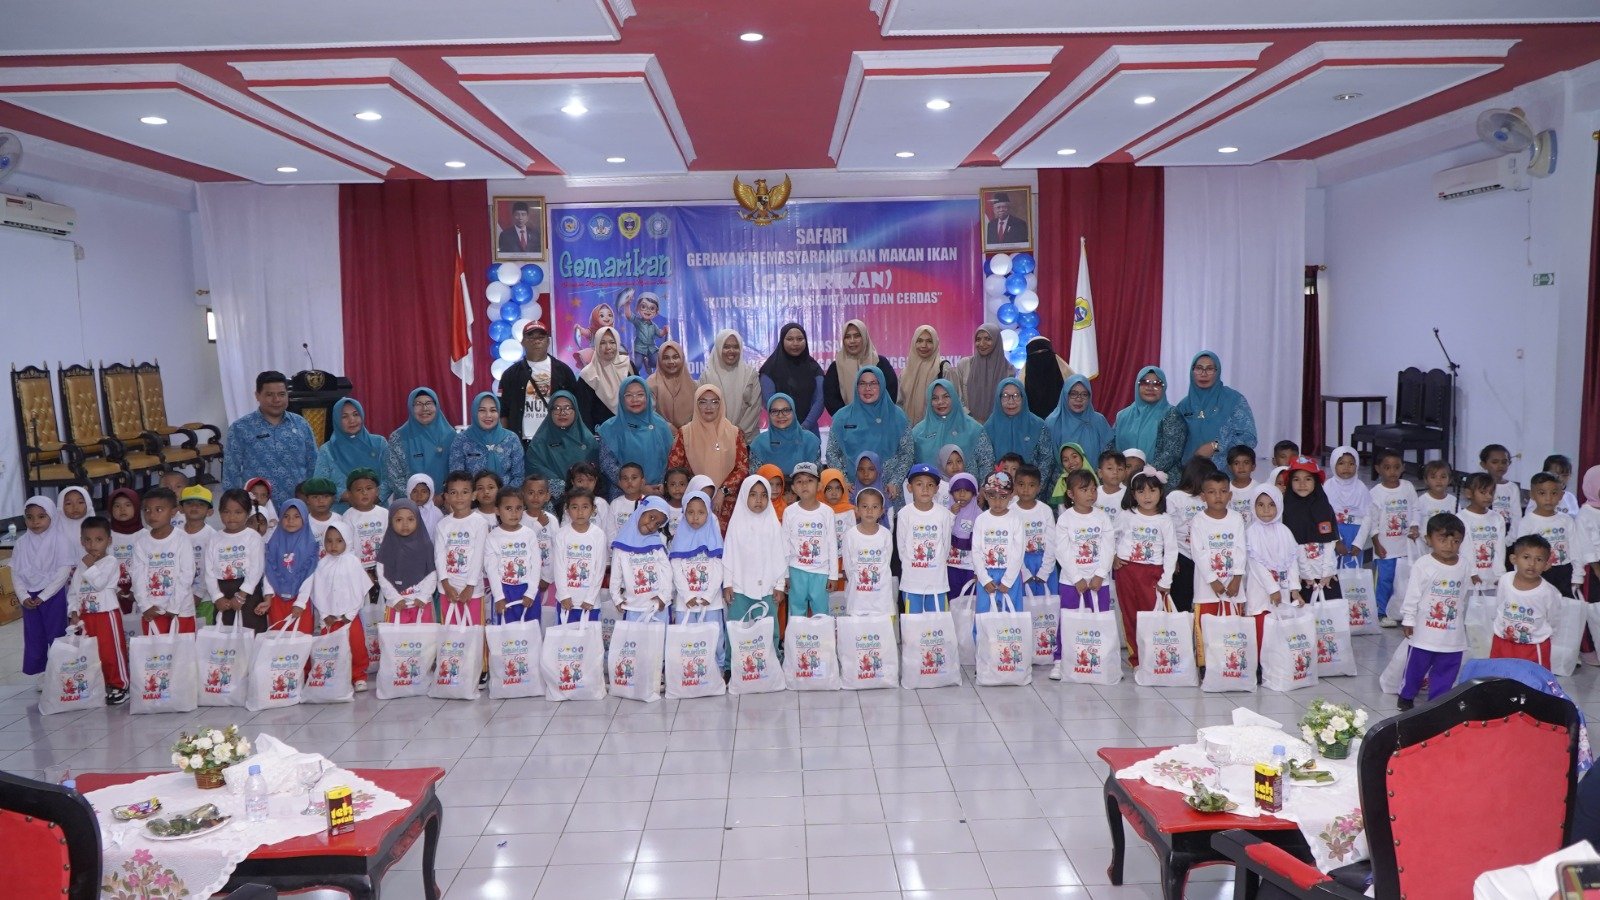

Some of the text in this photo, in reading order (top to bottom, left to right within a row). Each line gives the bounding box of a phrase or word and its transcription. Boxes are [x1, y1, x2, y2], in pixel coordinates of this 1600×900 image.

[796, 228, 847, 244] SAFARI
[560, 248, 672, 279] Gemarikan
[686, 252, 743, 267] GERAKAN
[879, 248, 925, 262] MAKAN
[928, 247, 957, 261] IKAN
[843, 294, 869, 305] KUAT
[873, 293, 892, 304] DAN
[1255, 782, 1273, 795] teh
[331, 802, 353, 818] teh
